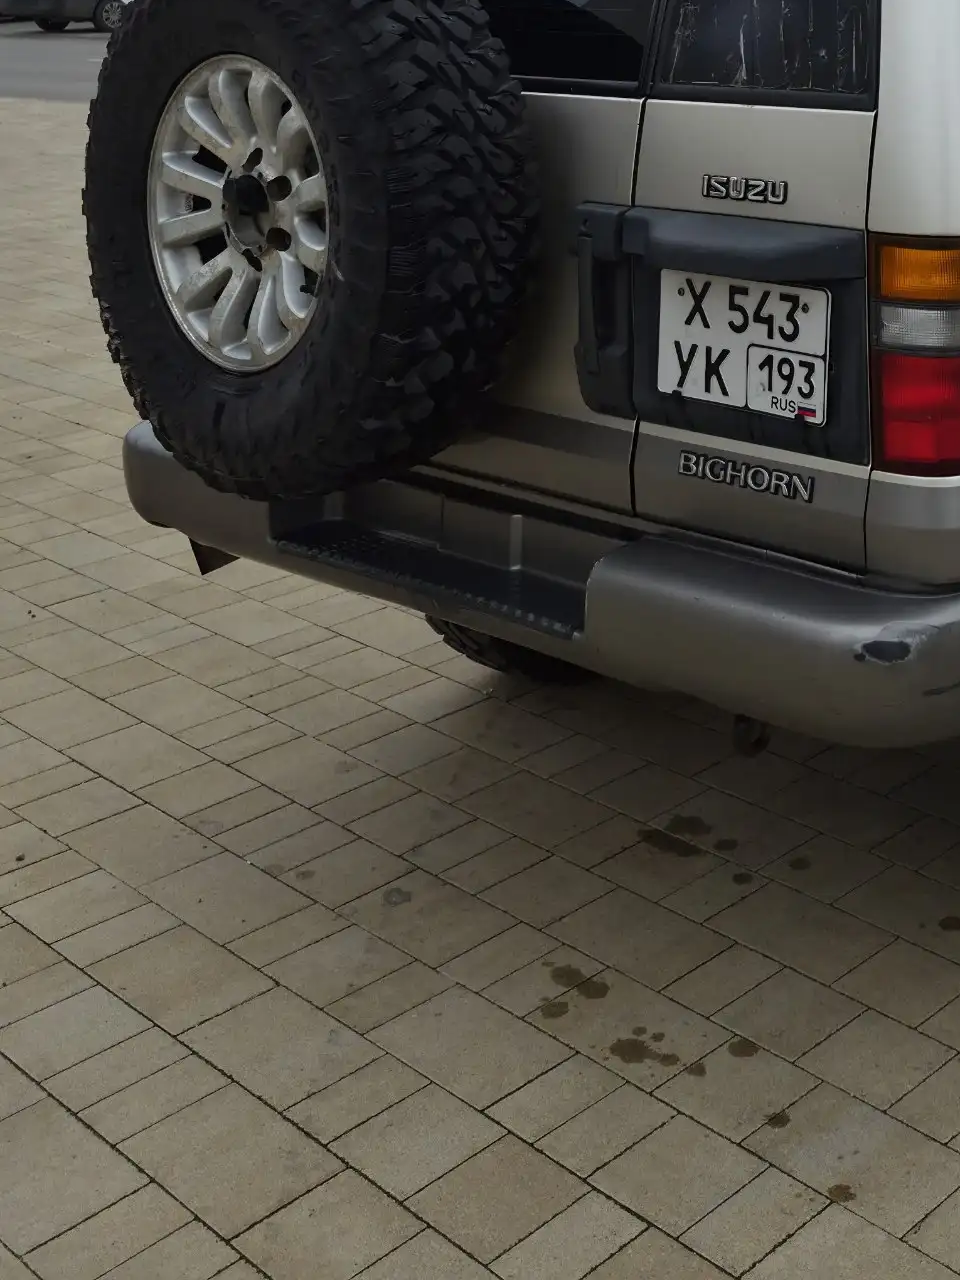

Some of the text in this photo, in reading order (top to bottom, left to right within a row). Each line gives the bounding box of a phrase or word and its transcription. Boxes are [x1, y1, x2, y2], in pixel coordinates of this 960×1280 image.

[701, 174, 788, 205] ISUZU
[727, 284, 800, 343] 543
[758, 354, 816, 399] 193
[770, 395, 797, 414] RUS
[677, 449, 815, 503] BIGHORN
